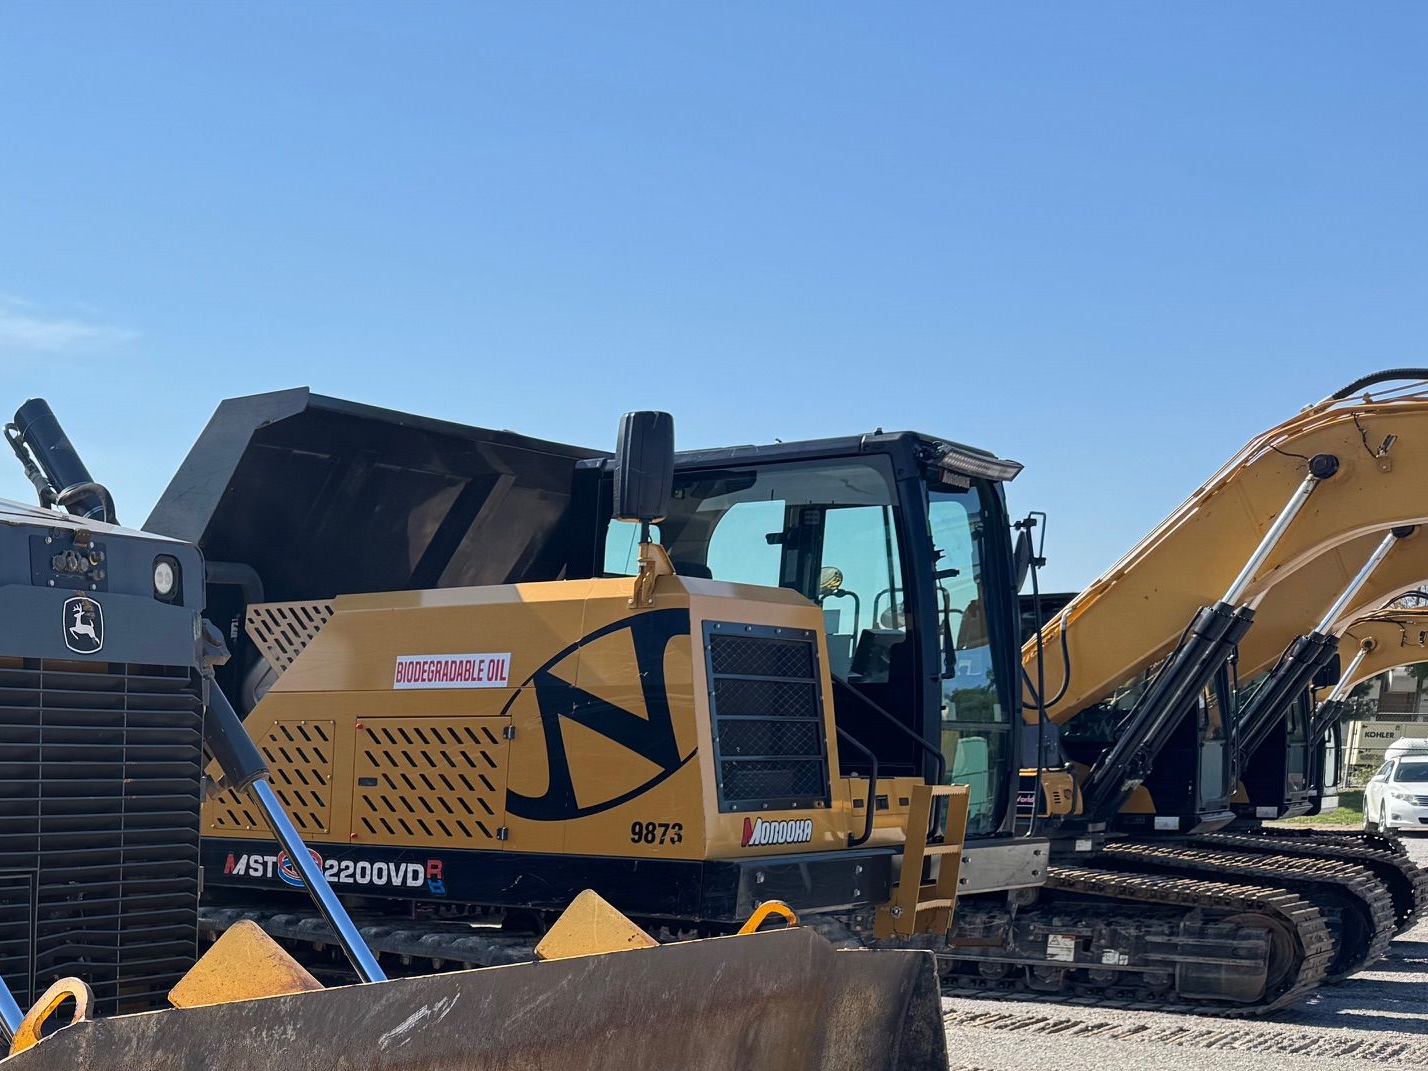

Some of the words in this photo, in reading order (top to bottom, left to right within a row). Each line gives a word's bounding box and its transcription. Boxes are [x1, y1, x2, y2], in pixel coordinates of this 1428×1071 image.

[395, 659, 485, 683] BIODEGRADABLE
[486, 658, 507, 682] OIL
[1364, 731, 1395, 739] KOHLER
[630, 821, 683, 845] 9873
[224, 853, 278, 878] MST
